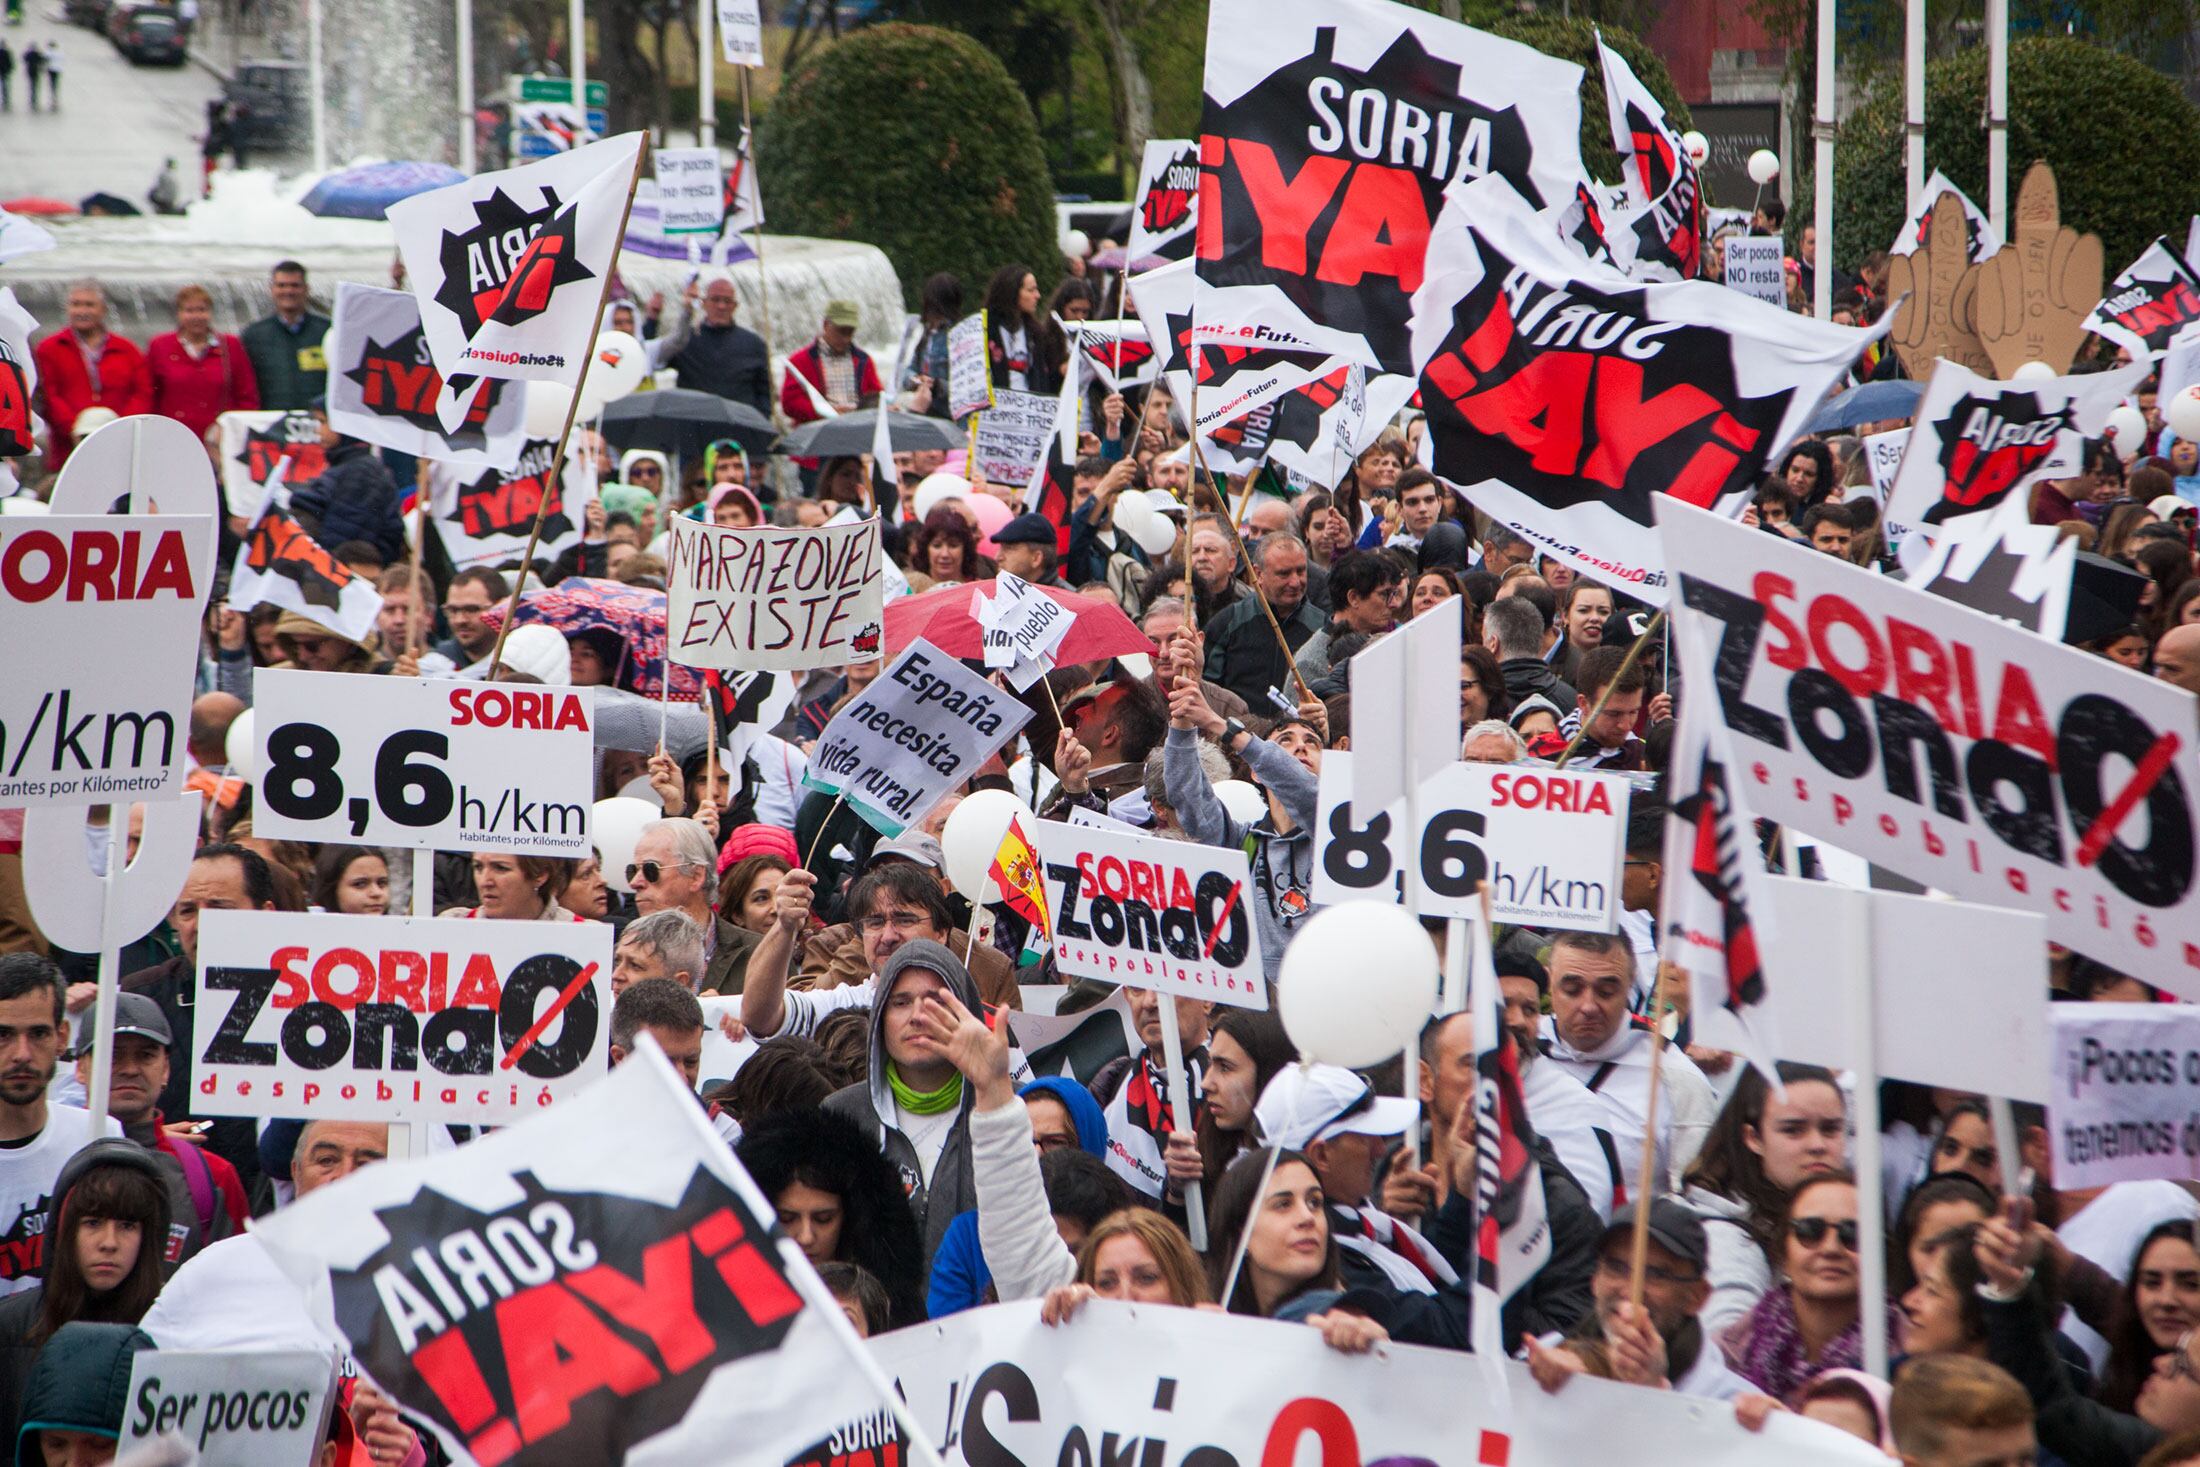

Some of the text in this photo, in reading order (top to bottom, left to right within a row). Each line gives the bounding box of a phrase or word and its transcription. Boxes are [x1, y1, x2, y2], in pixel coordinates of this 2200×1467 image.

[1308, 76, 1492, 184] SORIA
[1194, 134, 1432, 293] ¡YA
[1728, 267, 1780, 284] NO resta
[1750, 246, 1780, 263] pocos
[2028, 289, 2045, 318] OS
[2026, 332, 2044, 358] UE
[0, 530, 195, 603] ORIA
[668, 525, 881, 594] MARAZOVEL
[681, 590, 861, 651] EXISTE
[1014, 601, 1060, 652] pueblo
[891, 651, 1003, 737] España
[1752, 570, 2060, 775] SORIA
[450, 688, 589, 732] SORIA
[849, 700, 961, 777] necesita
[50, 779, 79, 798] por
[263, 722, 586, 837] 8,6 h/km
[817, 737, 925, 820] vida rural.
[1491, 773, 1613, 815] SORIA
[459, 832, 512, 844] Habitantes
[514, 836, 530, 846] por
[1751, 760, 2200, 969] espoblación
[1075, 852, 1197, 914] SORIA
[1493, 861, 1605, 911] h/km
[269, 945, 502, 1015] SORIA
[1058, 942, 1256, 993] despoblación
[200, 1072, 553, 1108] despoblació
[131, 1376, 311, 1453] Ser pocos
